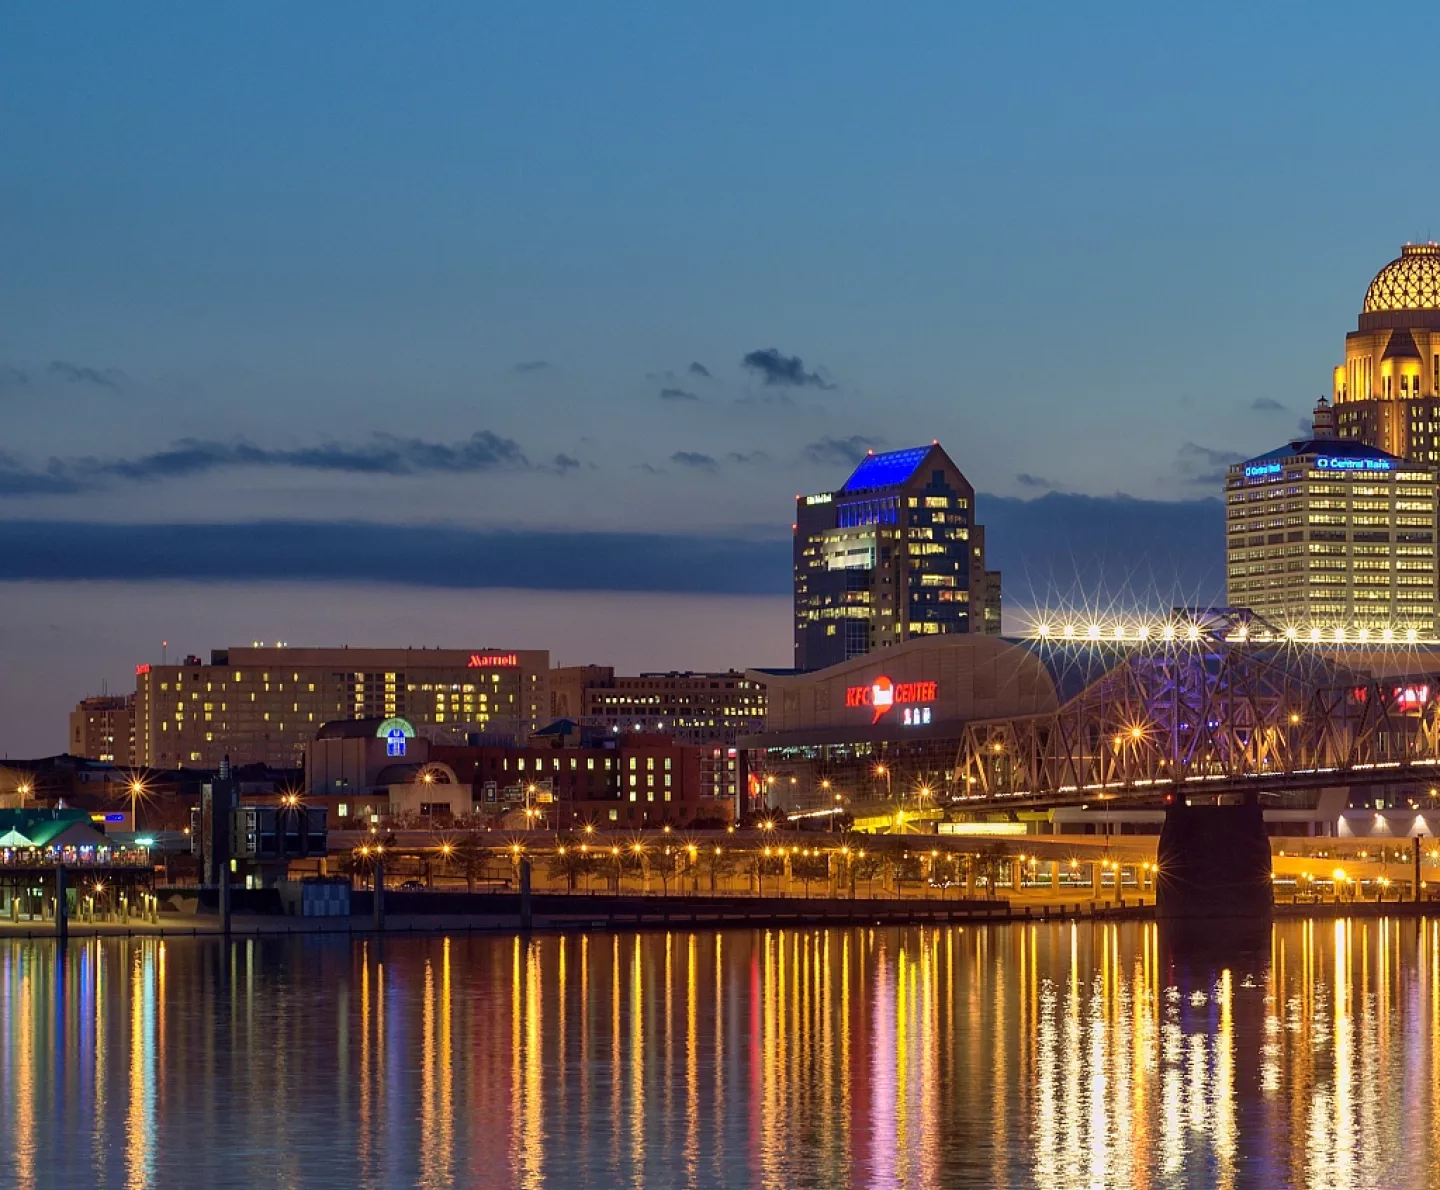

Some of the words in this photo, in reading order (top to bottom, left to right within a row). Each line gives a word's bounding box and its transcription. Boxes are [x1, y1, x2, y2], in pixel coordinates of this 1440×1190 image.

[1330, 458, 1364, 468] Central
[1366, 459, 1390, 469] Bank
[467, 654, 517, 667] Marriott
[845, 686, 870, 707] KFC
[895, 681, 937, 703] CENTER
